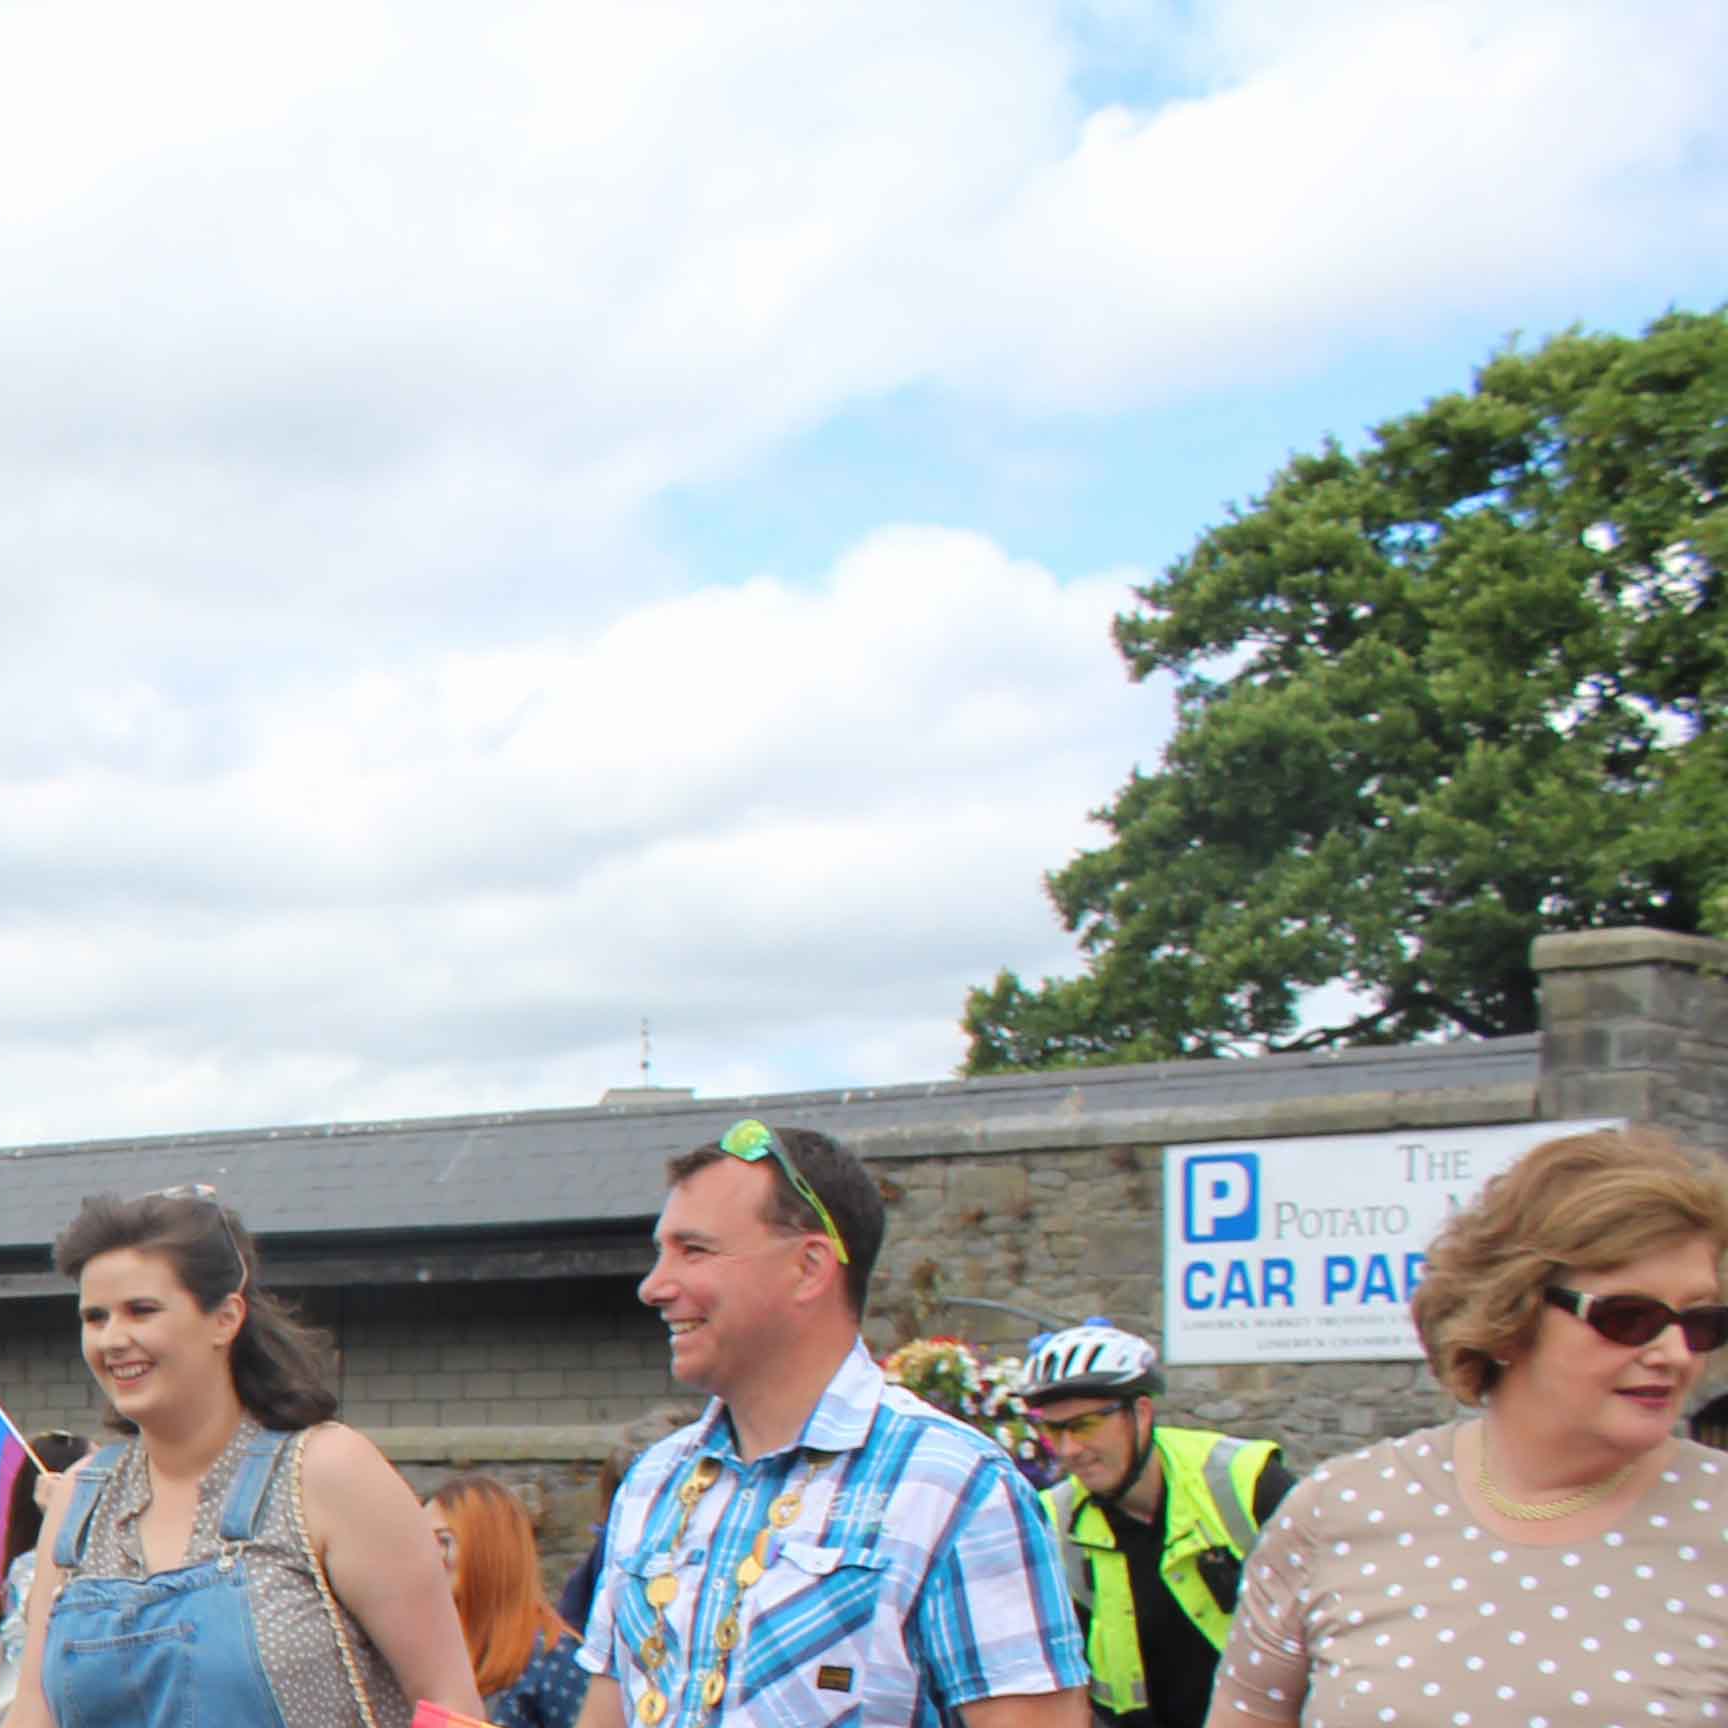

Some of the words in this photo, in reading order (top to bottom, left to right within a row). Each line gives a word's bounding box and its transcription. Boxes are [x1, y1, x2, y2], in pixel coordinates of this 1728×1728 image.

[1396, 1144, 1474, 1183] THE
[1192, 1161, 1250, 1237] P
[1274, 1201, 1410, 1240] POTATO
[1183, 1257, 1296, 1310] CAR
